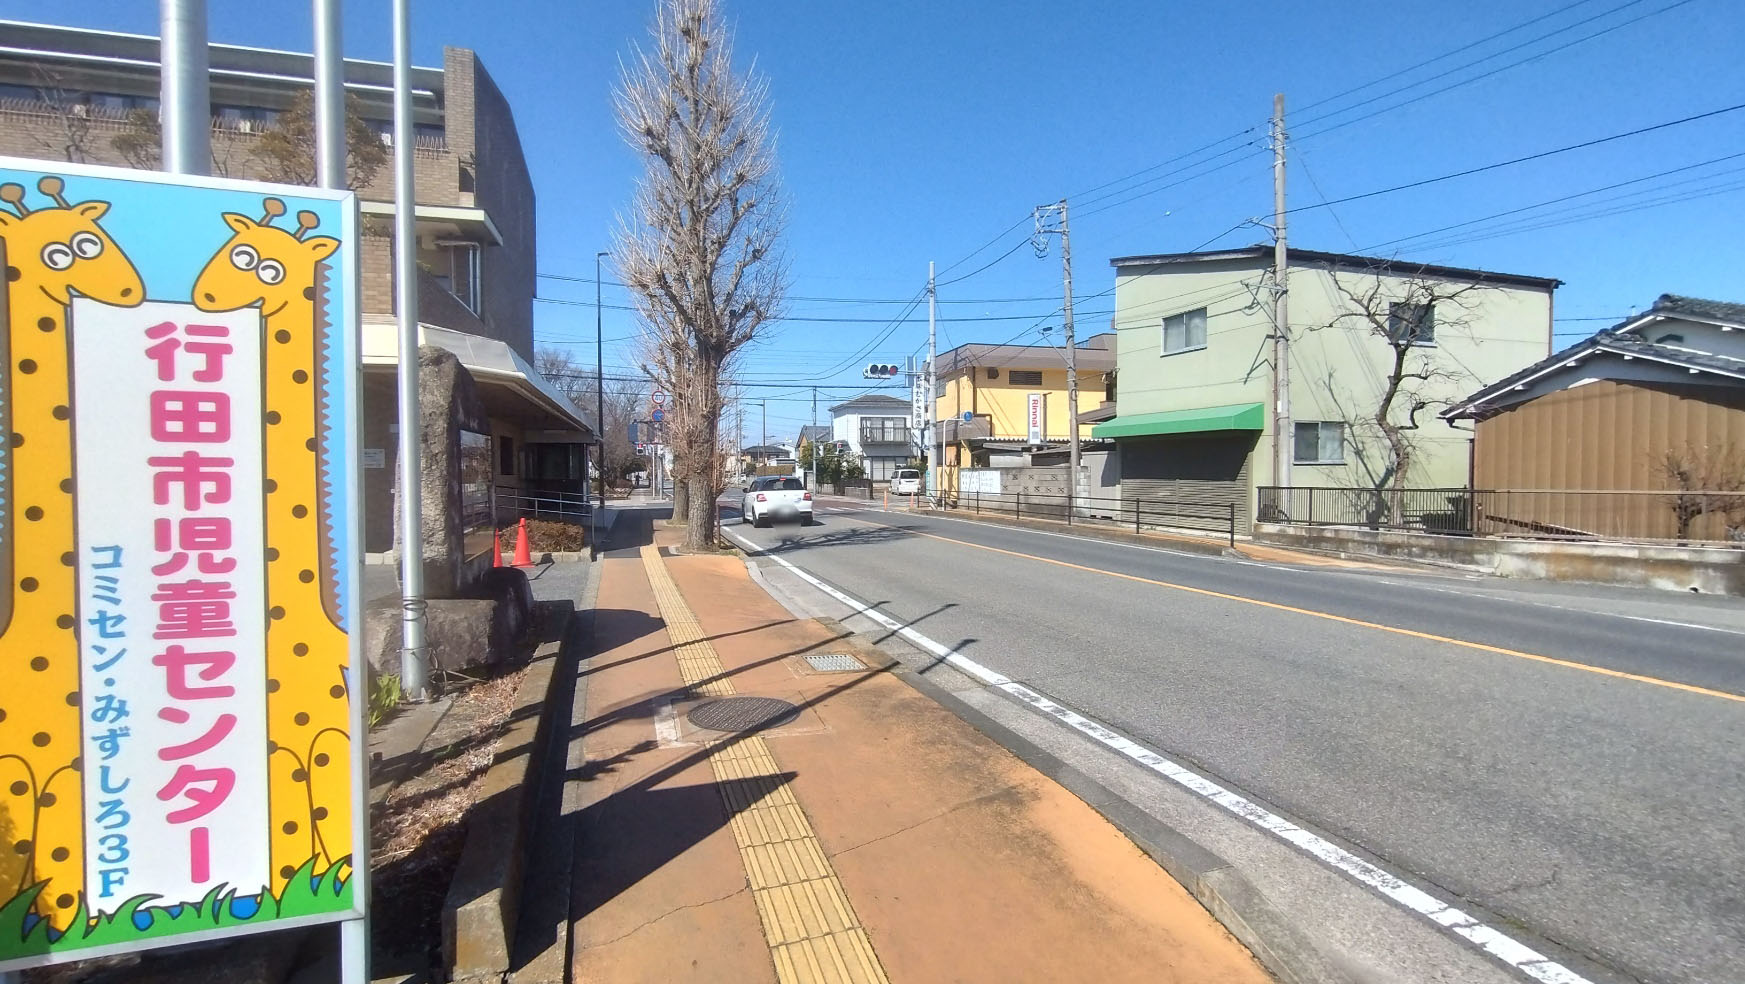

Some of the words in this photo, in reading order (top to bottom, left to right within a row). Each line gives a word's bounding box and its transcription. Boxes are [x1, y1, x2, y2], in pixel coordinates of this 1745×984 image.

[88, 544, 132, 898] コミセン・みずしろ3F
[145, 320, 237, 884] 行田市児童センター
